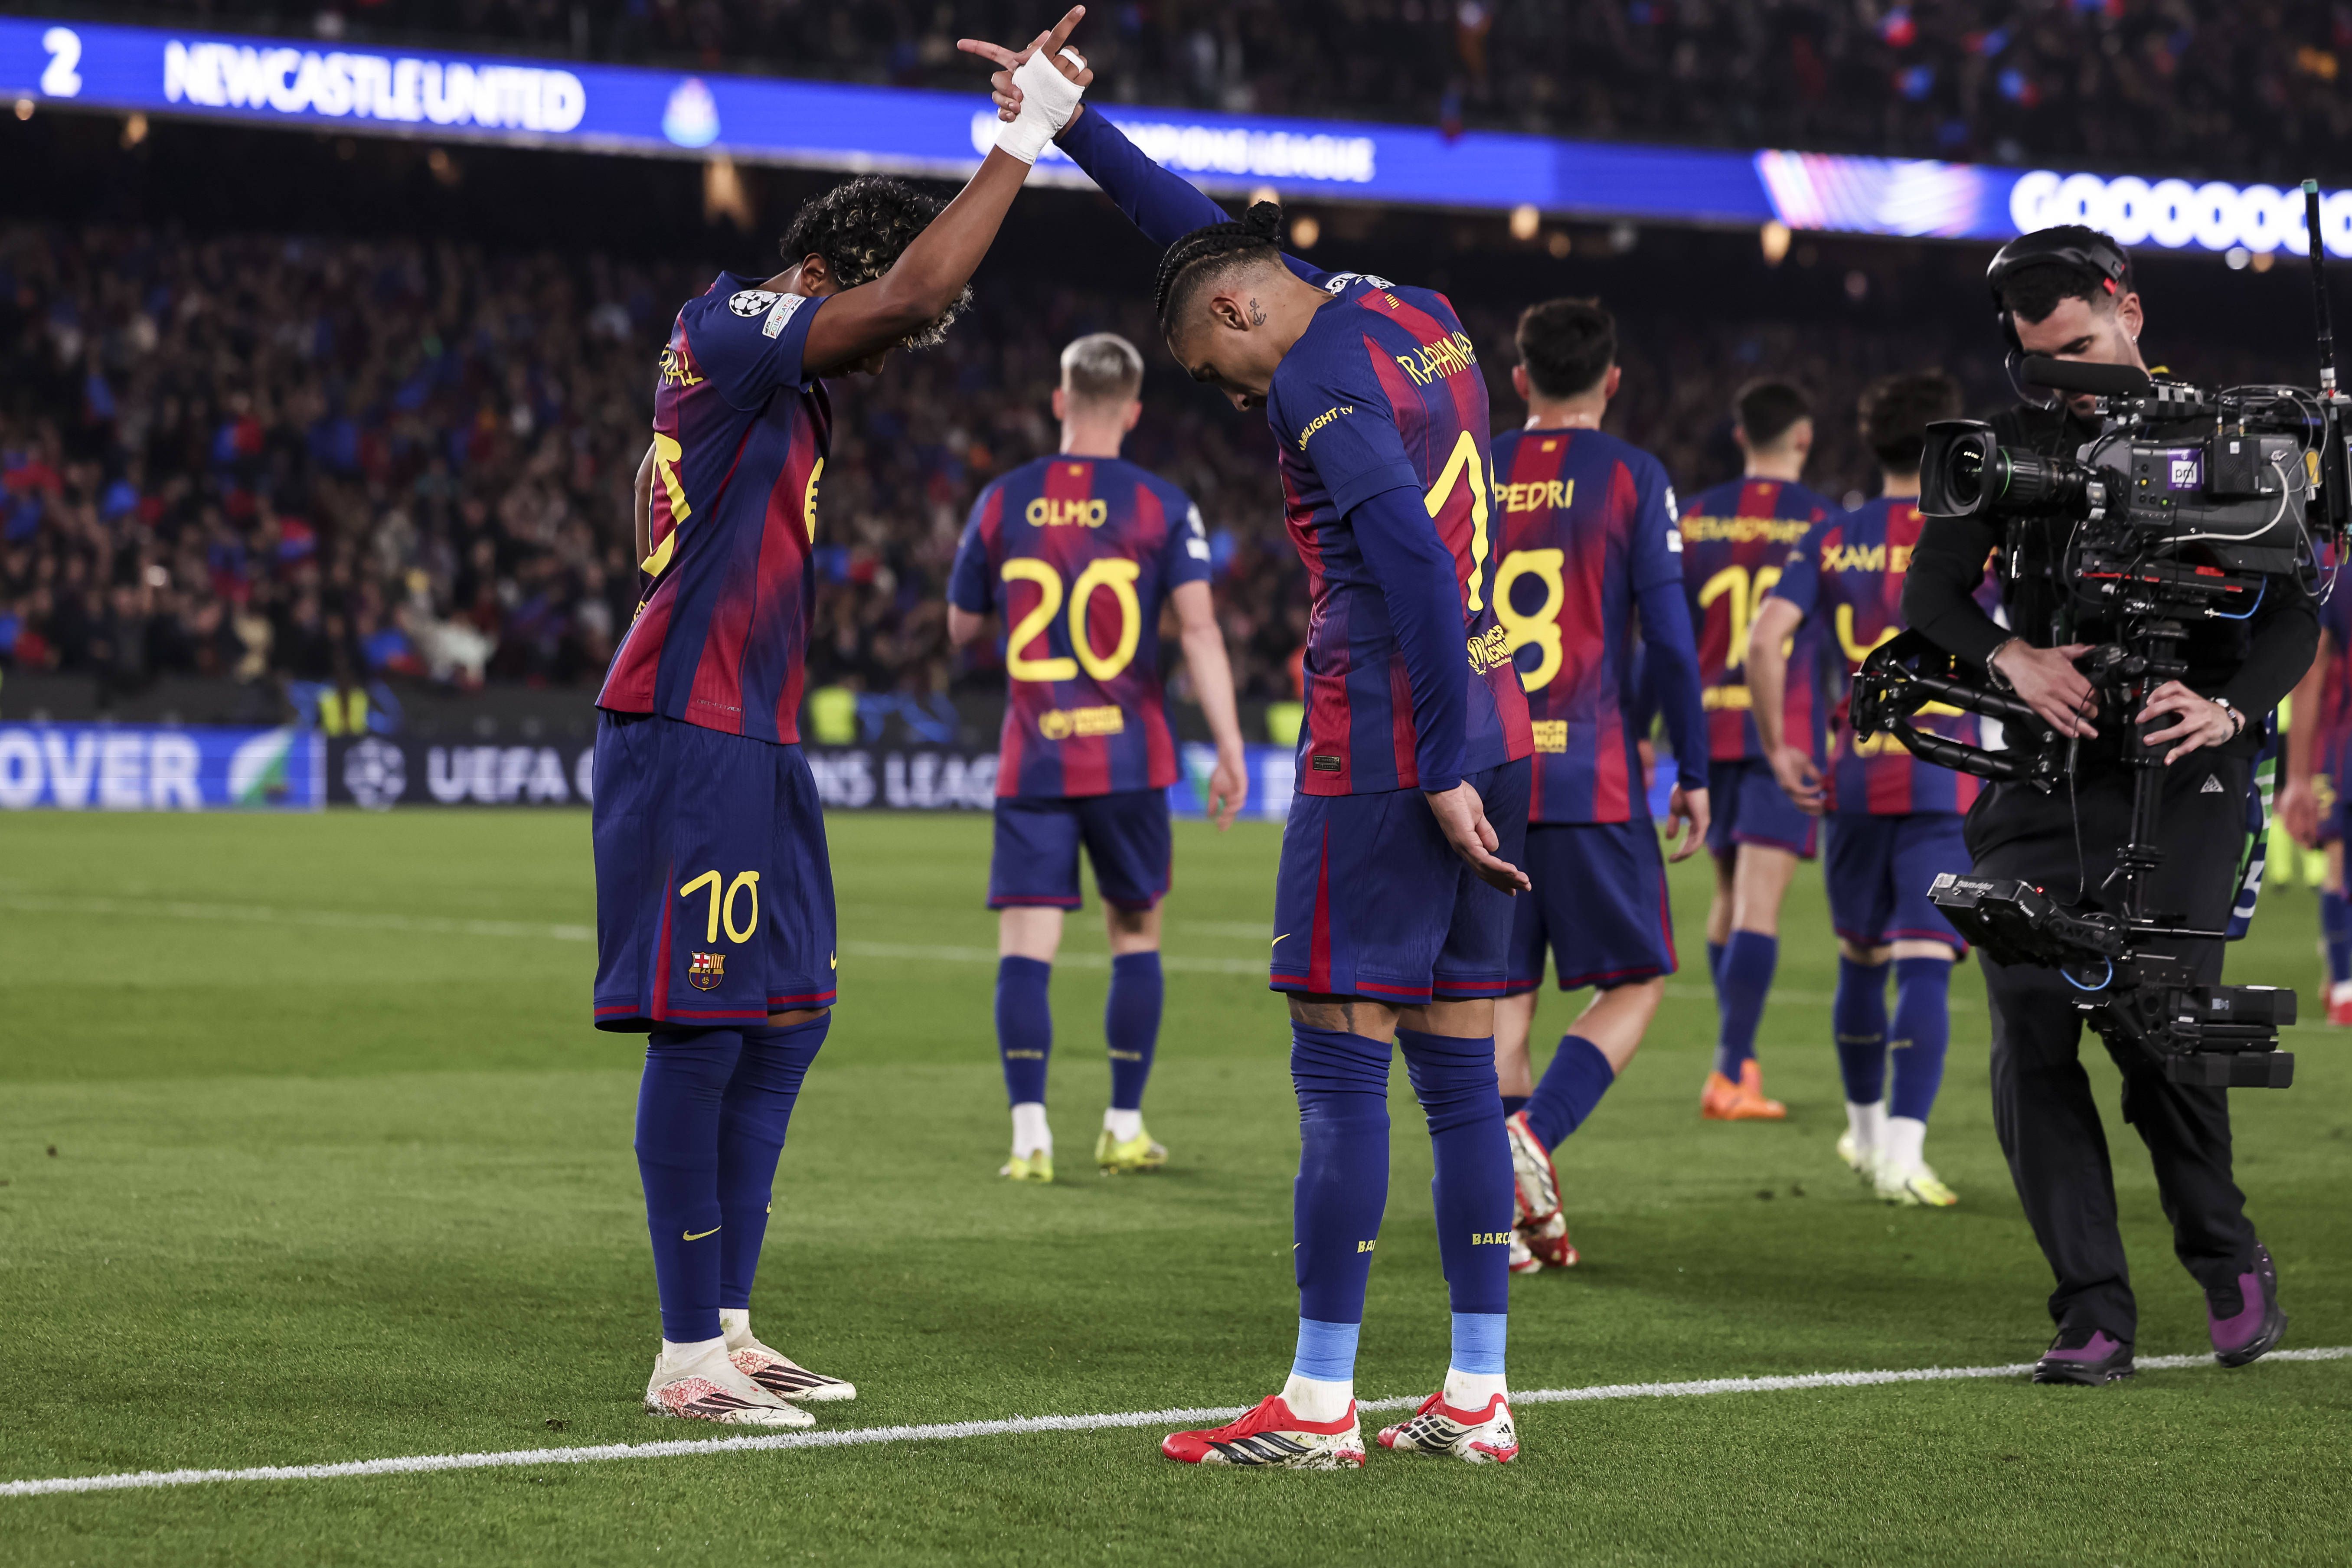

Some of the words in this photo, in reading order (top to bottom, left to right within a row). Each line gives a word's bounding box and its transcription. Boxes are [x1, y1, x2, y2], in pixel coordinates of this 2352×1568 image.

[40, 27, 82, 99] 2
[164, 39, 426, 123] NEWCASTLE
[422, 60, 586, 134] UNITED
[1340, 405, 1352, 415] tv
[1026, 497, 1107, 528] OLMO
[1496, 478, 1575, 513] PEDRI
[1001, 557, 1141, 682] 20
[1492, 548, 1565, 693] 8
[427, 744, 571, 804] UEFA
[680, 870, 760, 944] 10
